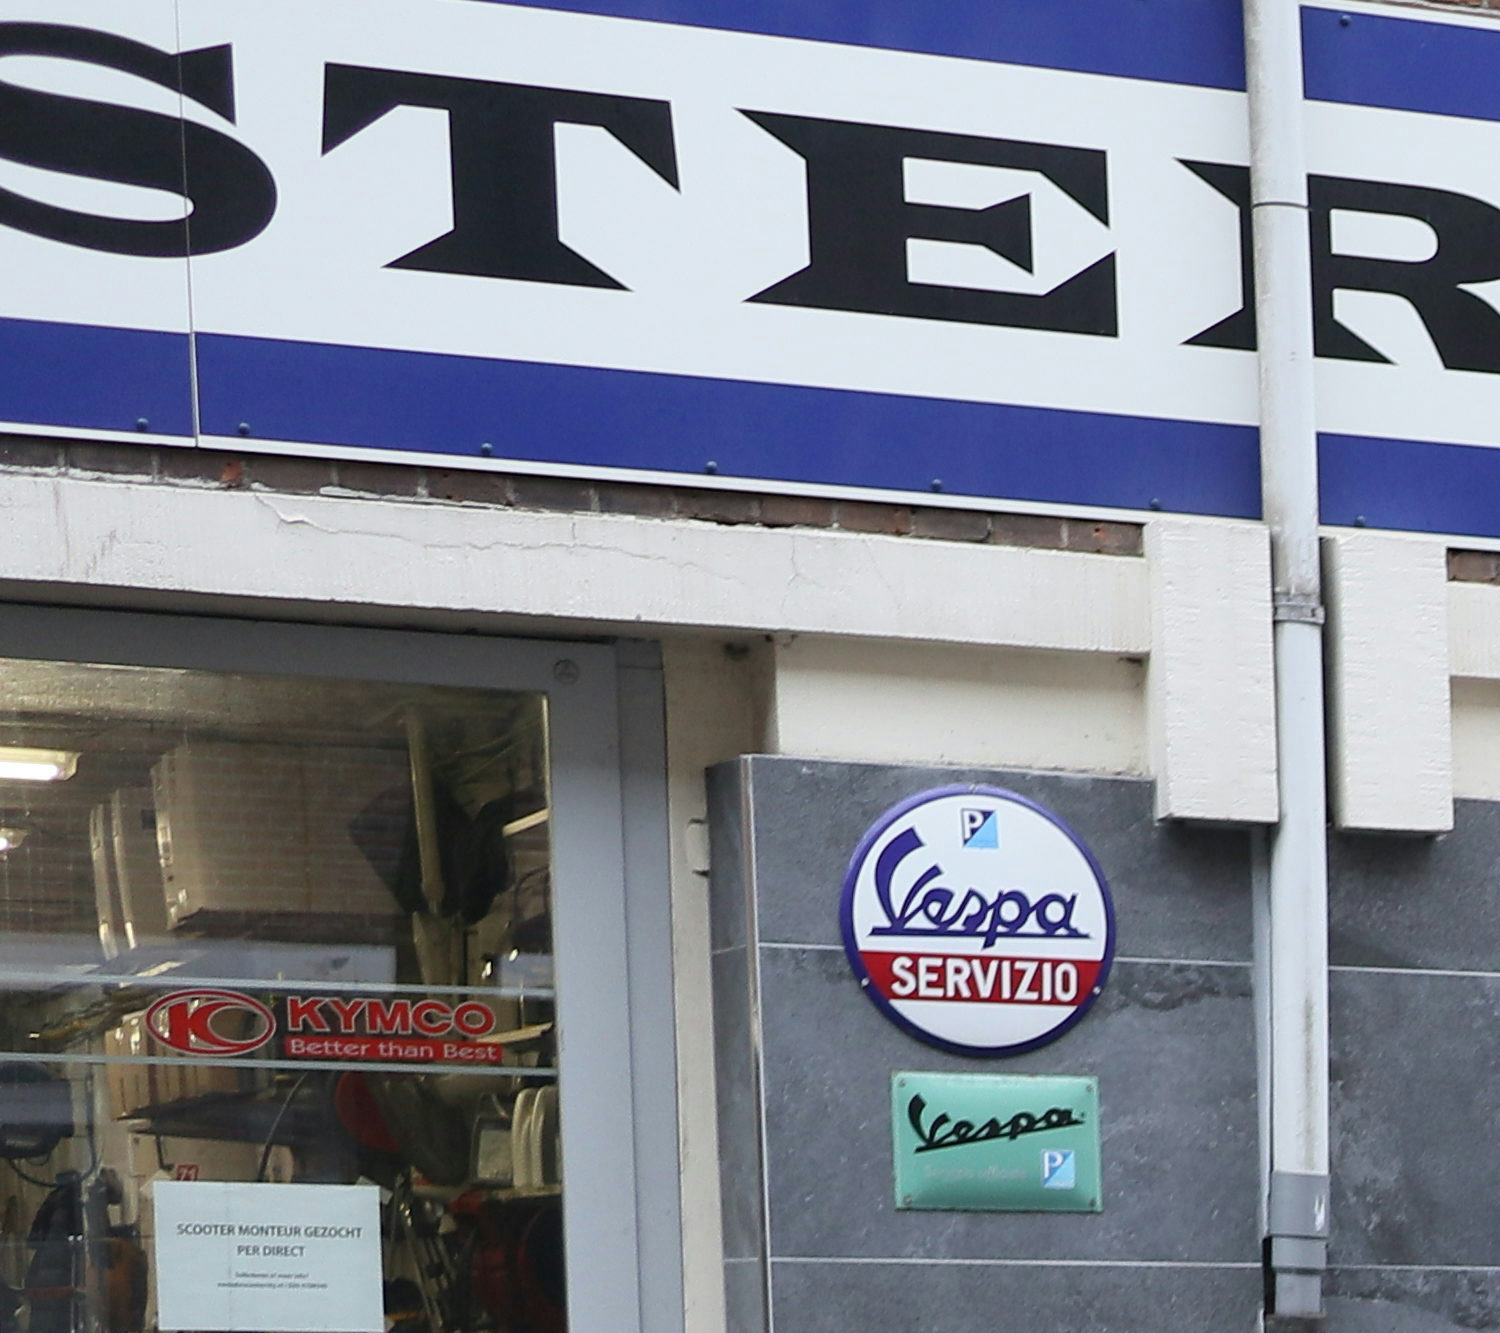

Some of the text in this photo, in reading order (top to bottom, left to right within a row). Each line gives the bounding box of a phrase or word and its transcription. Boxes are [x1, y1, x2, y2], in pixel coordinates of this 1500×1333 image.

[868, 827, 1092, 949] Vespa
[890, 956, 1079, 1003] SERVIZIO
[286, 996, 496, 1037] KYMCO
[290, 1039, 497, 1061] Better than Best
[908, 1093, 1085, 1153] Vespa
[176, 1223, 363, 1239] SCOOTER MONTEUR GEZOCHT
[237, 1245, 306, 1258] PER DIRECT
